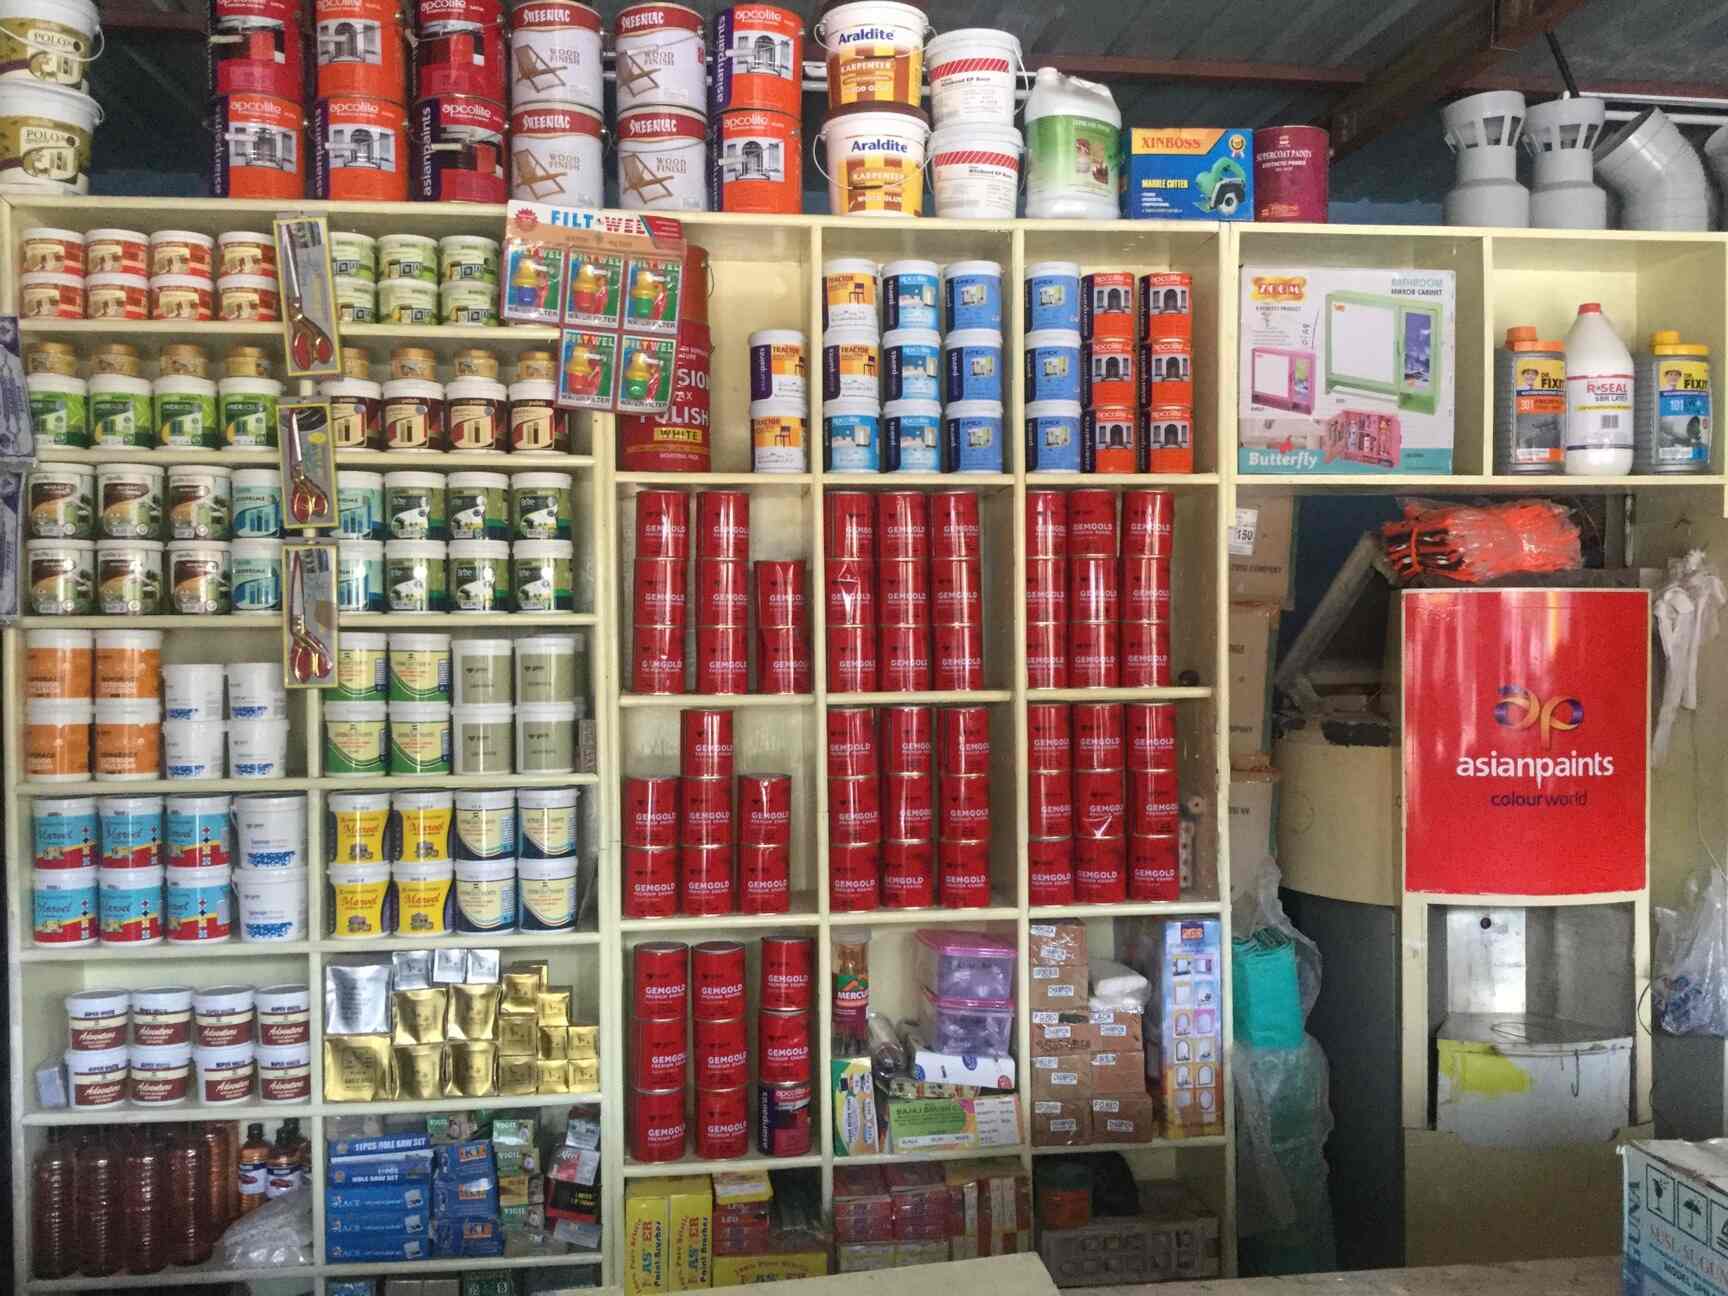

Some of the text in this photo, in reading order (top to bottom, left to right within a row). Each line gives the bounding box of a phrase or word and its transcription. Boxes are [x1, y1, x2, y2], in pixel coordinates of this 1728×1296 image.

[838, 29, 895, 45] Araldite
[523, 115, 571, 130] SHEENLAC
[629, 121, 677, 137] SHEENLAC
[851, 140, 908, 153] Araldite
[1142, 136, 1201, 149] XINBOSS
[421, 106, 433, 197] asianpaints
[551, 209, 594, 229] FILT
[677, 368, 710, 390] SIO
[639, 405, 709, 427] OLISH
[659, 429, 699, 441] WHITE
[1248, 452, 1318, 469] Butterfly
[1456, 750, 1615, 789] asianpaints
[768, 975, 808, 983] GEMGOLD
[646, 984, 686, 994] GEMGOLD
[702, 984, 743, 994] GEMGOLD
[768, 1047, 808, 1056] GEMGOLD
